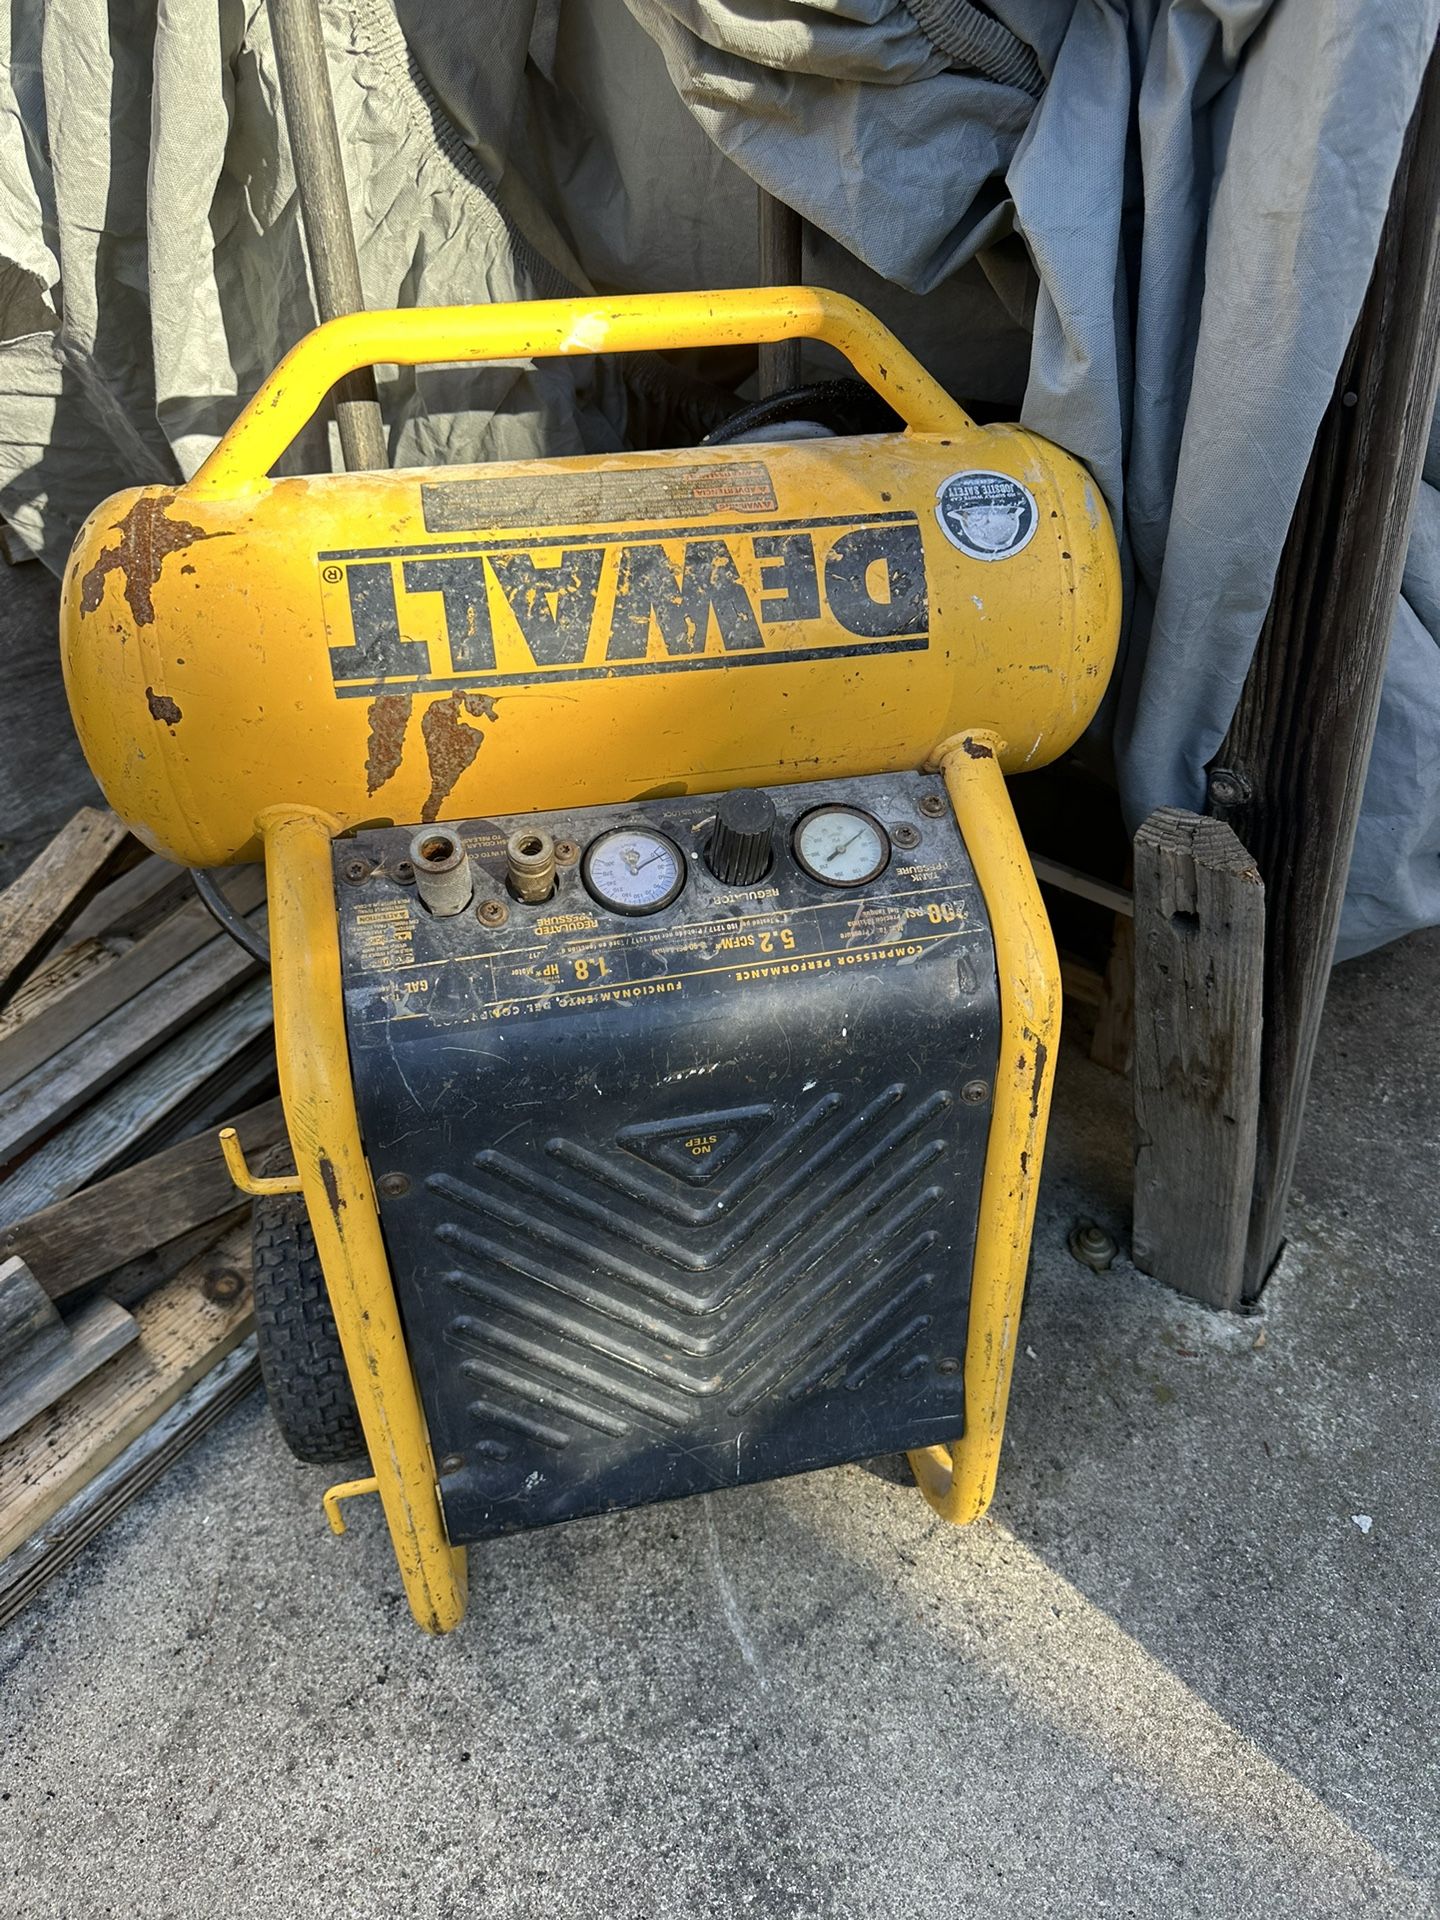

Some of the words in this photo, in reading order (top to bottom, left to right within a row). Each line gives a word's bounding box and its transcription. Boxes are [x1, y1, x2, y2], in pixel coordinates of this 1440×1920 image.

[947, 486, 979, 497] SAFETY
[981, 483, 1015, 494] JOBSITE
[328, 525, 928, 680] DEWALT
[910, 871, 939, 882] TANK
[712, 888, 780, 905] REGULATOR
[359, 912, 399, 923] ATTENTION
[927, 900, 969, 923] 200
[534, 919, 599, 936] REGULATED
[709, 924, 726, 932] 1217
[758, 929, 796, 952] 5.2
[837, 945, 923, 966] COMPRESSOR
[511, 966, 534, 976] Motor
[575, 956, 608, 981] 1.8
[735, 959, 831, 981] PERFORMANCE
[404, 979, 429, 993] GAL
[685, 1135, 717, 1147] STEP
[692, 1145, 711, 1155] NO
